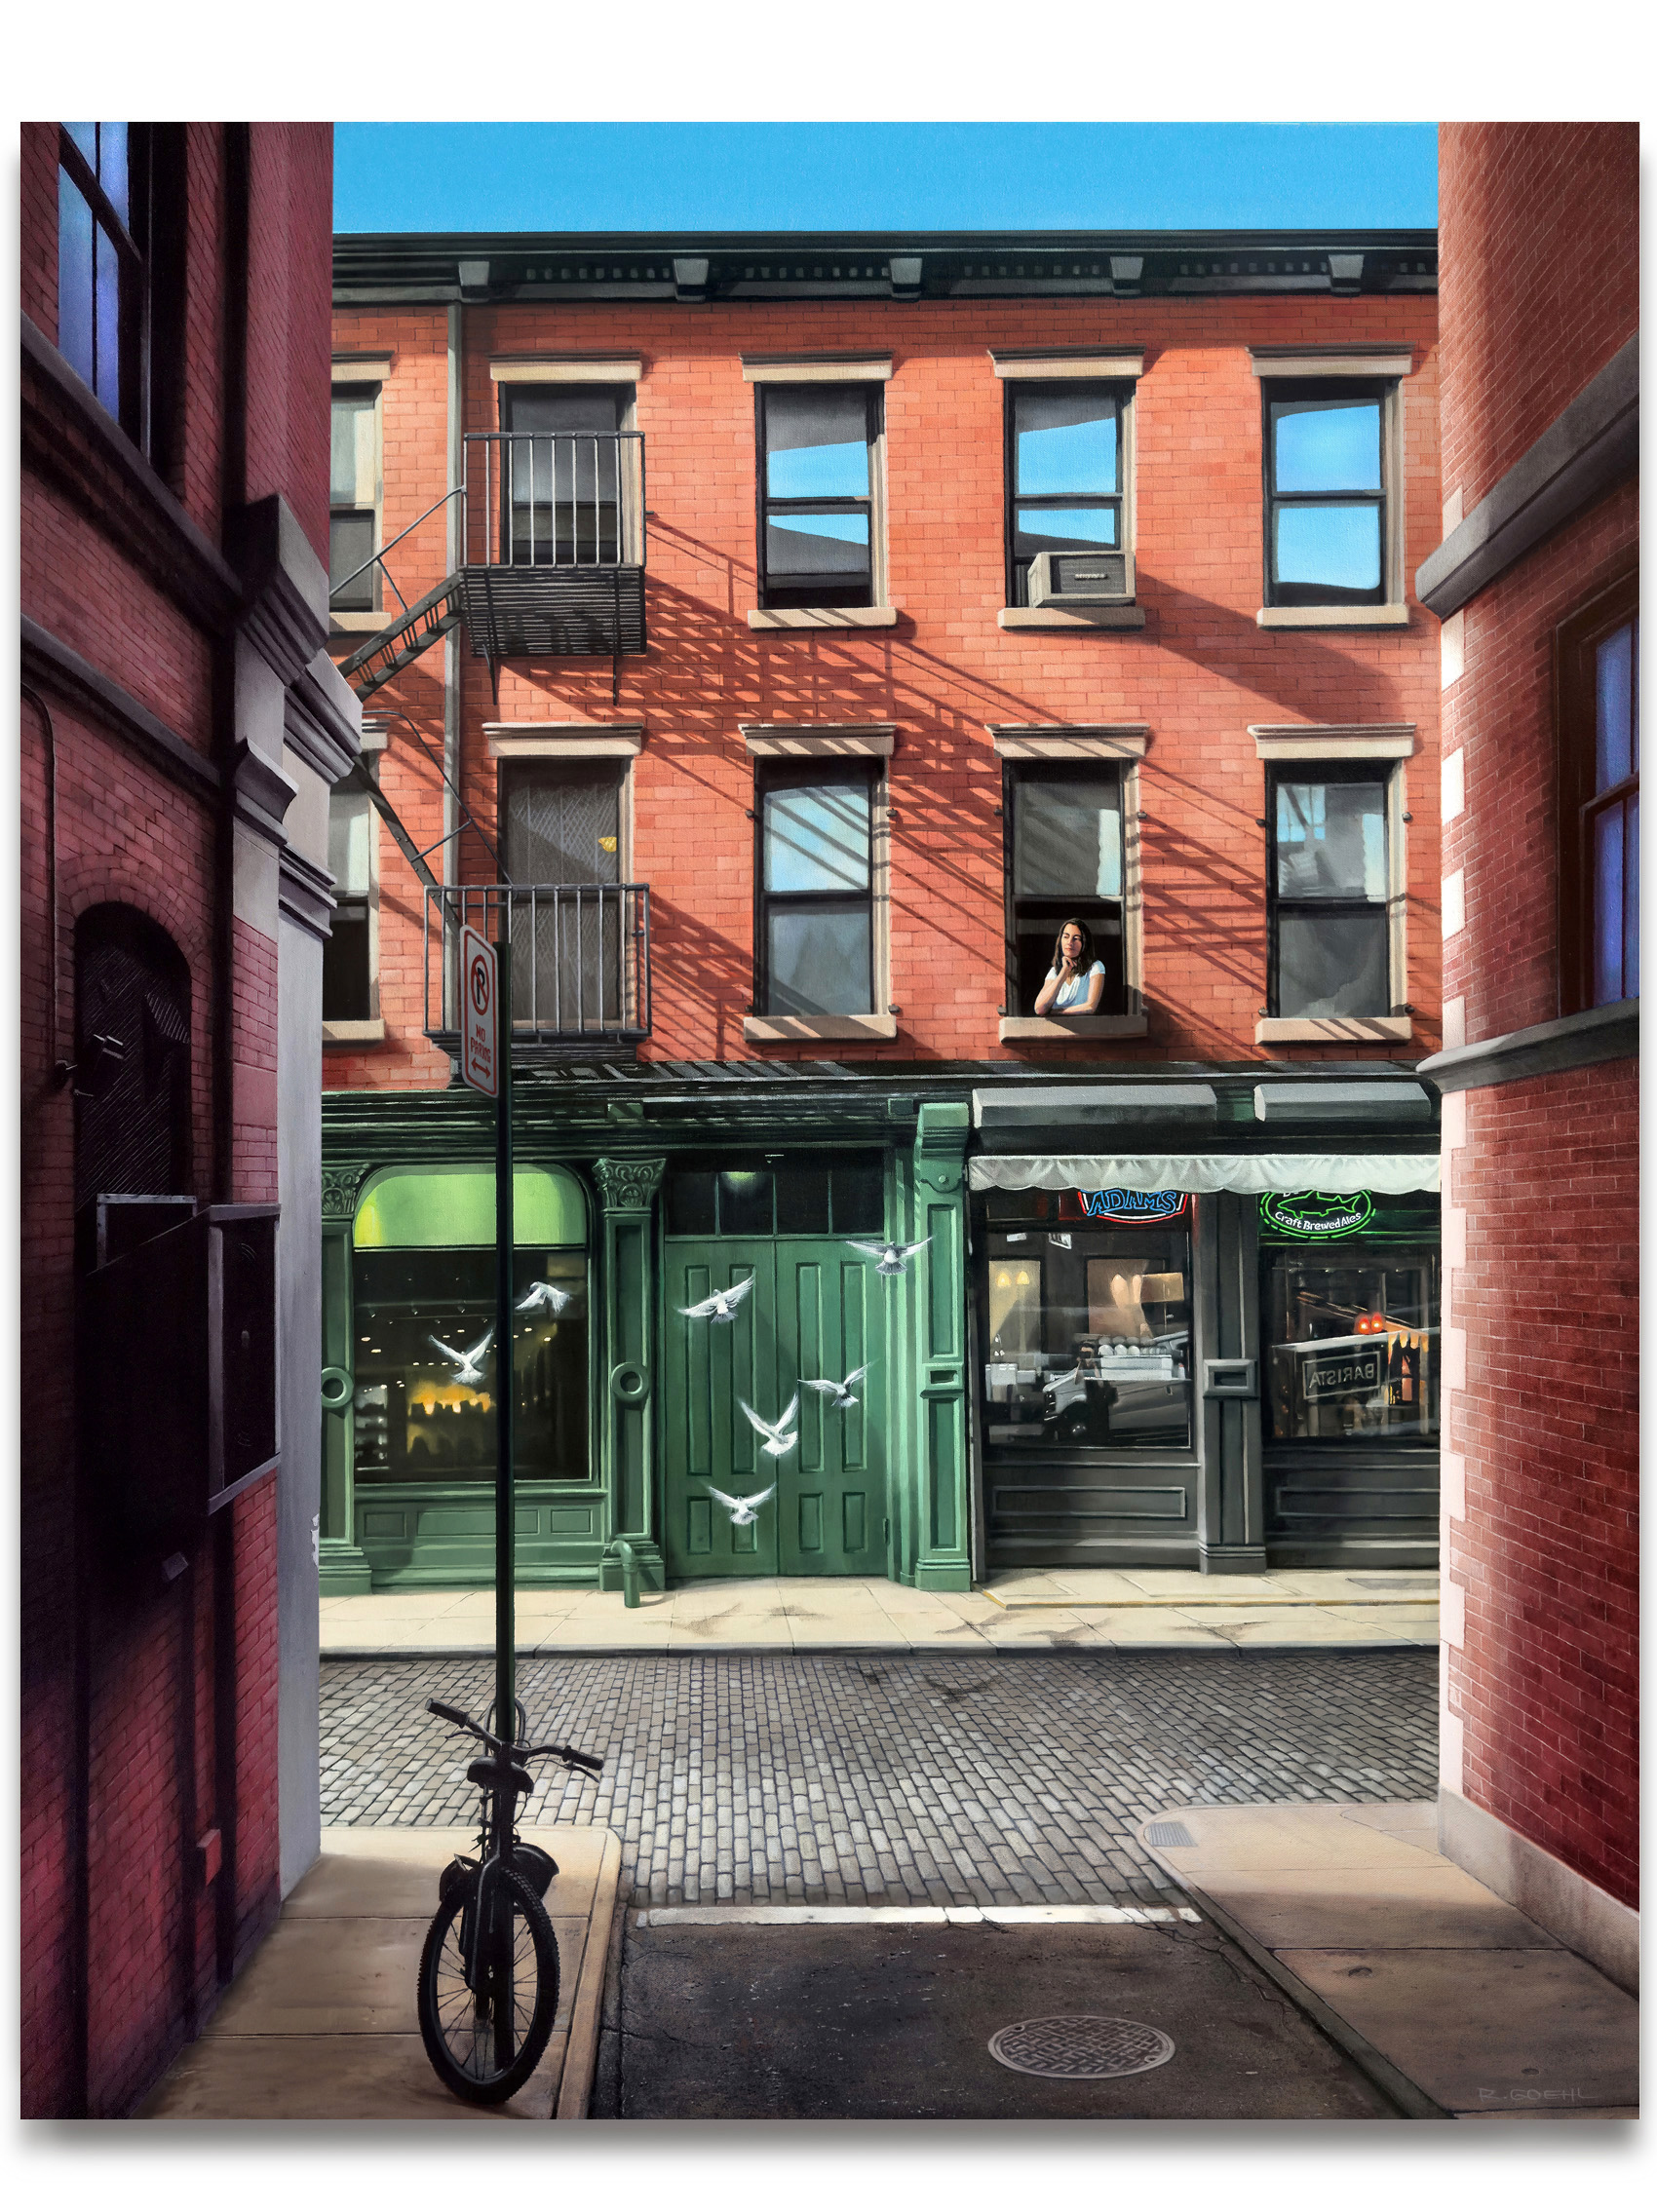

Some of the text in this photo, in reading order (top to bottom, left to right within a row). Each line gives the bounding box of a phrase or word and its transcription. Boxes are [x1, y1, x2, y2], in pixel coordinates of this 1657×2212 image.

[476, 967, 485, 1005] P
[476, 1023, 486, 1043] NO
[470, 1037, 491, 1064] PARKING
[1087, 1189, 1176, 1217] ADAMS
[1275, 1211, 1362, 1231] Craft Brewed Ales
